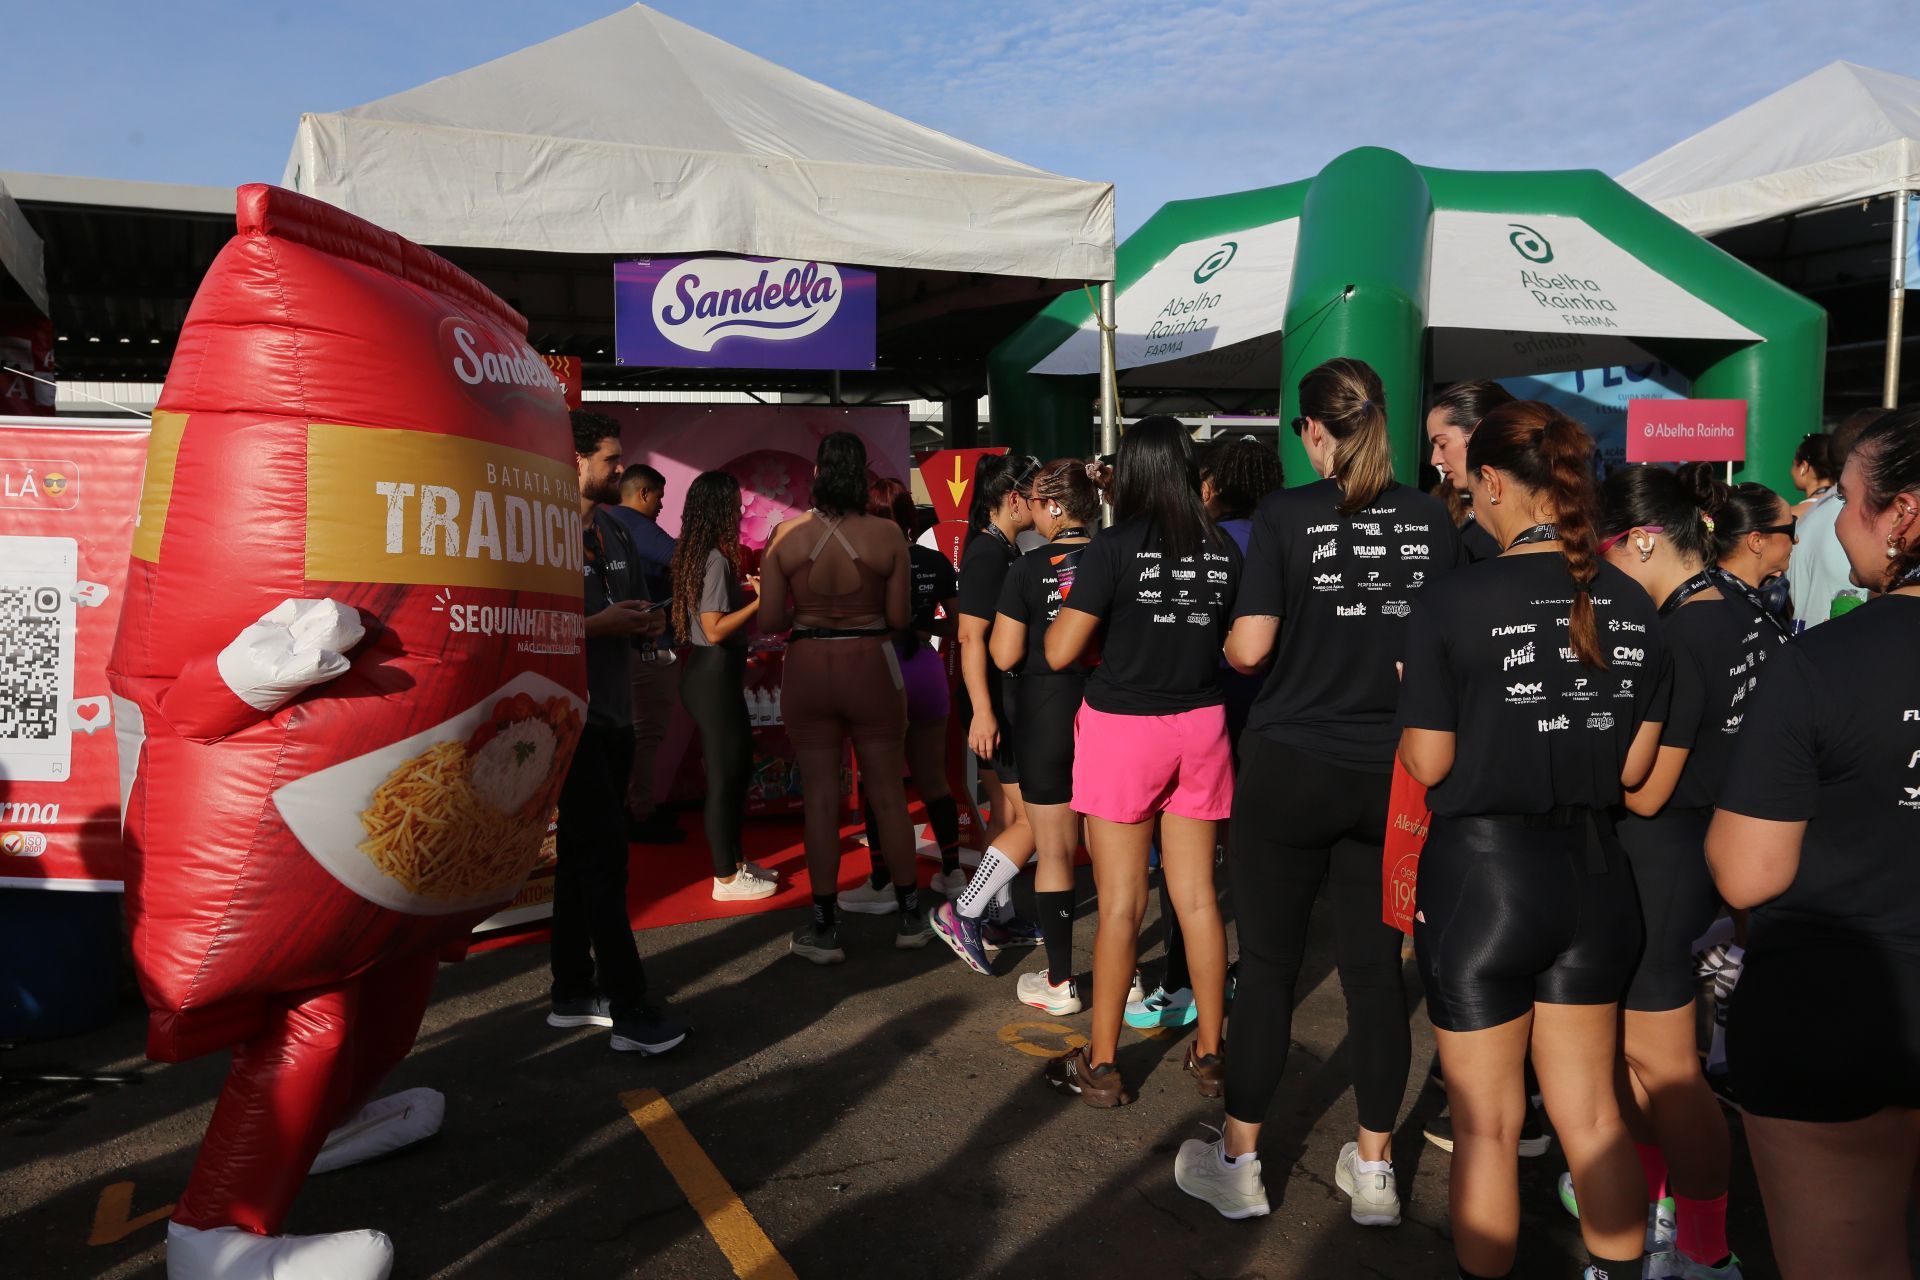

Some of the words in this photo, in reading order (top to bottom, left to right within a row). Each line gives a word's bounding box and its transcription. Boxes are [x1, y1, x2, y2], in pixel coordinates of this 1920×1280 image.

[1520, 270, 1601, 291] Abelha
[661, 261, 837, 326] Sandella
[1531, 290, 1617, 311] Rainha
[1158, 292, 1221, 318] Abelha
[1145, 315, 1208, 340] Rainha
[1562, 314, 1618, 328] FARMA
[1144, 341, 1183, 358] FARMA
[1655, 424, 1694, 437] Abelha
[1697, 423, 1734, 437] Rainha
[4, 468, 39, 497] LÁ
[487, 463, 550, 495] BATATA
[556, 479, 580, 504] PALH
[376, 481, 583, 574] TRADICIO
[1404, 524, 1429, 532] Sicredi
[1312, 547, 1337, 563] fruit
[1318, 544, 1329, 552] La
[1353, 546, 1387, 556] VULCANO
[1400, 544, 1430, 555] CMO
[1207, 570, 1228, 580] CMO
[1590, 596, 1612, 605] elcar
[1336, 603, 1367, 616] Italac
[449, 604, 546, 637] SEQUINHA
[1153, 613, 1176, 623] Italac
[517, 640, 535, 653] NÃO
[1510, 648, 1524, 658] La
[1613, 646, 1645, 661] CMO
[1503, 652, 1536, 671] fruit
[24, 836, 42, 846] ISO
